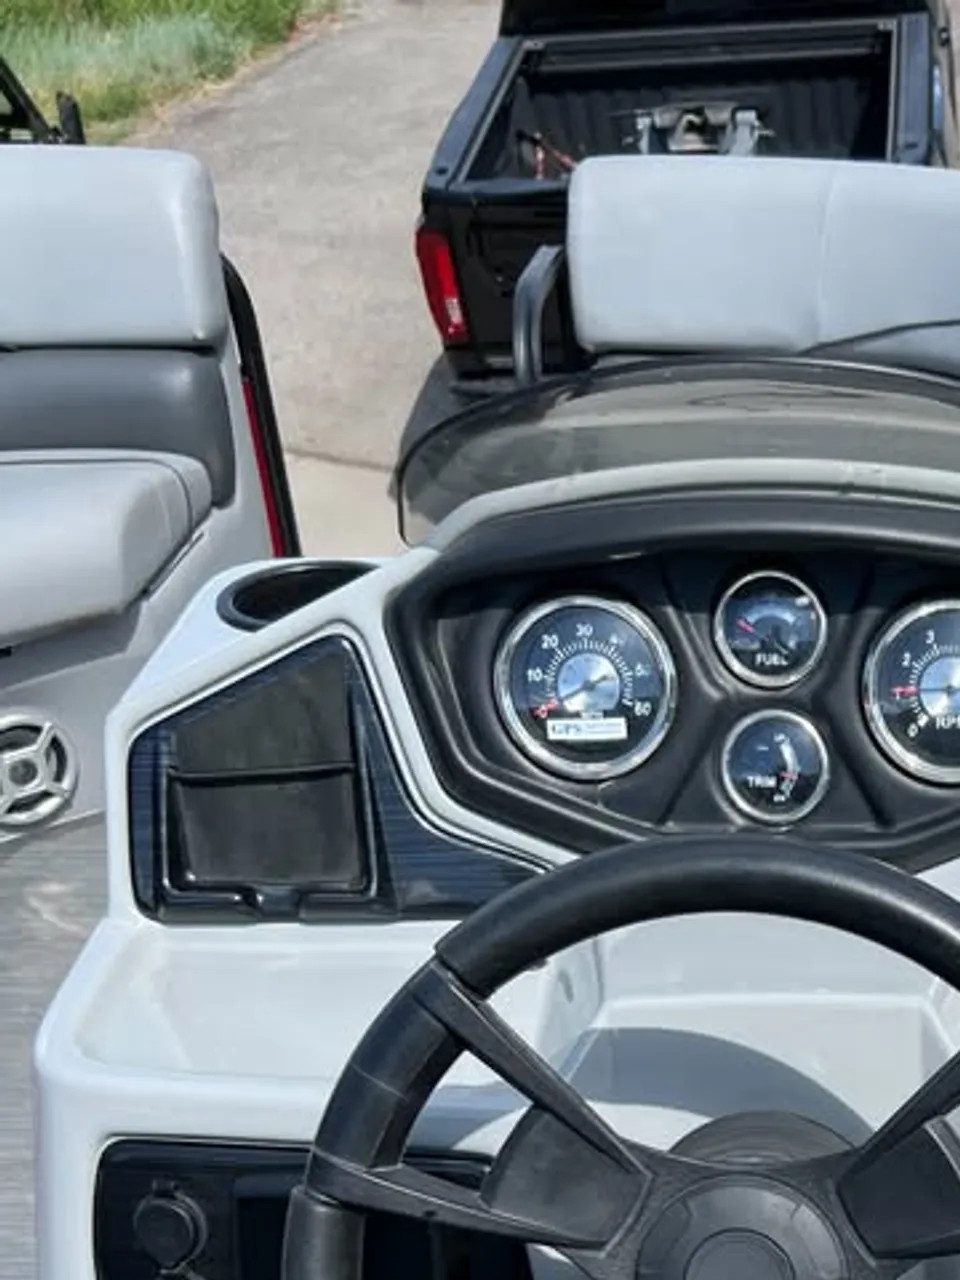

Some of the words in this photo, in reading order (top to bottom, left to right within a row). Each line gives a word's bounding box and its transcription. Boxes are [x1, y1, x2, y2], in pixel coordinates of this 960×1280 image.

[576, 623, 593, 637] 30
[541, 633, 559, 649] 20
[926, 630, 936, 645] 3
[755, 652, 789, 666] FUEL
[527, 667, 543, 683] 10
[747, 775, 778, 789] TRIM
